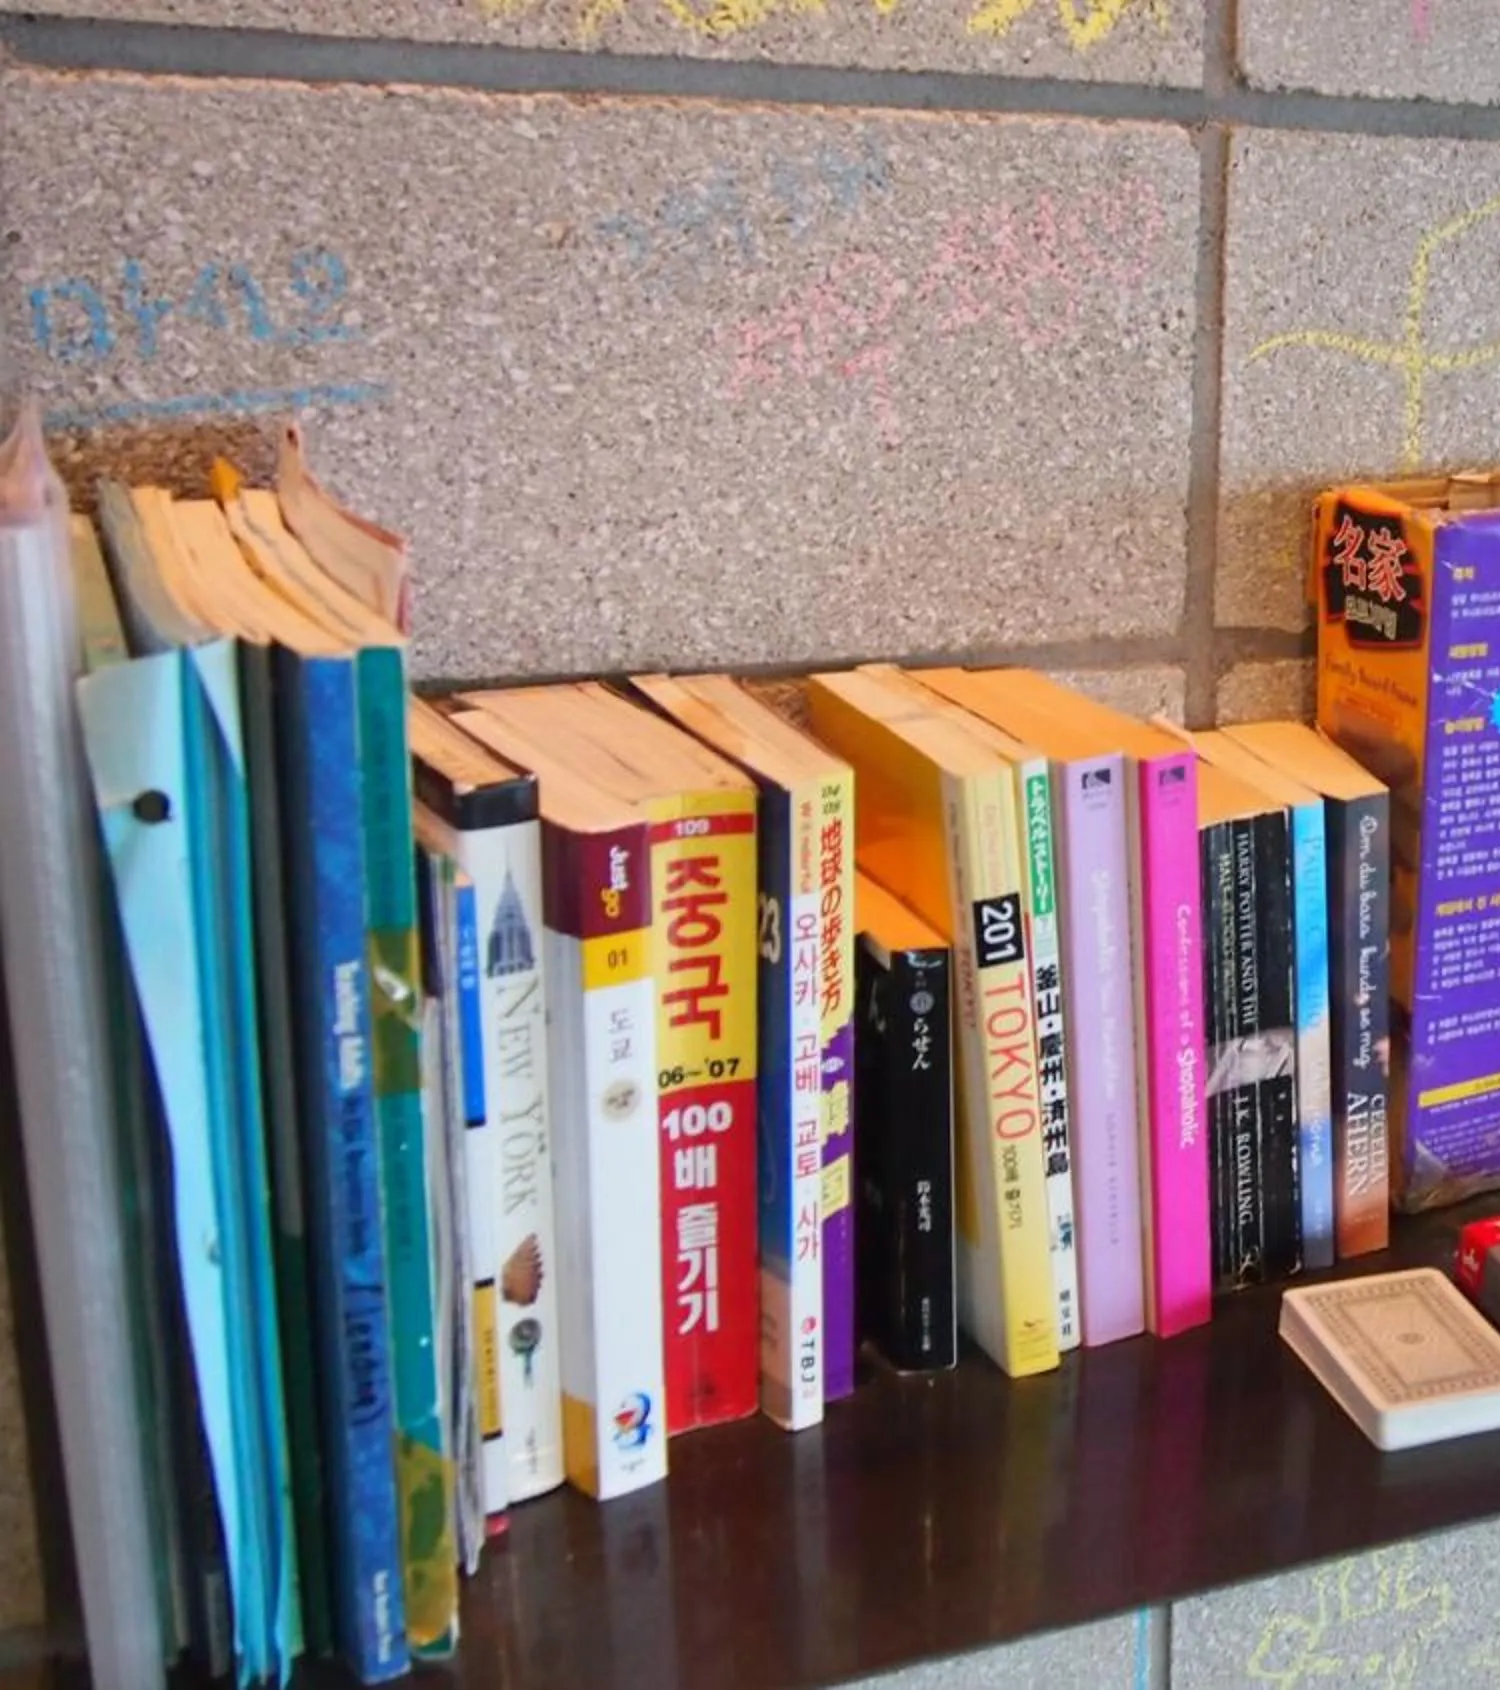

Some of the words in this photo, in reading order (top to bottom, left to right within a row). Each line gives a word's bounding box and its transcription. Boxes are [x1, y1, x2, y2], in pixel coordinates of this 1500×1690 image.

[1333, 514, 1408, 602] 名家
[601, 886, 622, 918] go
[609, 845, 630, 891] Just
[1236, 832, 1251, 885] HARRY
[607, 947, 629, 969] 01
[660, 854, 730, 1042] 중국
[794, 913, 819, 1006] 오사카
[820, 820, 844, 1020] 地球の歩き方
[1238, 891, 1253, 950] POTTER
[1241, 955, 1254, 991] AND
[497, 981, 543, 1078] NEW
[794, 1033, 819, 1094] 고베
[909, 1018, 932, 1070] らせん
[986, 975, 1036, 1140] TOKYO
[1177, 1046, 1197, 1149] Shopaholic
[1369, 1093, 1386, 1184] CECELIA
[500, 1094, 546, 1213] YORK
[795, 1119, 819, 1180] 교토
[1234, 1133, 1254, 1225] ROWLING
[1347, 1092, 1369, 1196] AHERN
[676, 1202, 720, 1336] 즐기기
[796, 1203, 820, 1261] 시가
